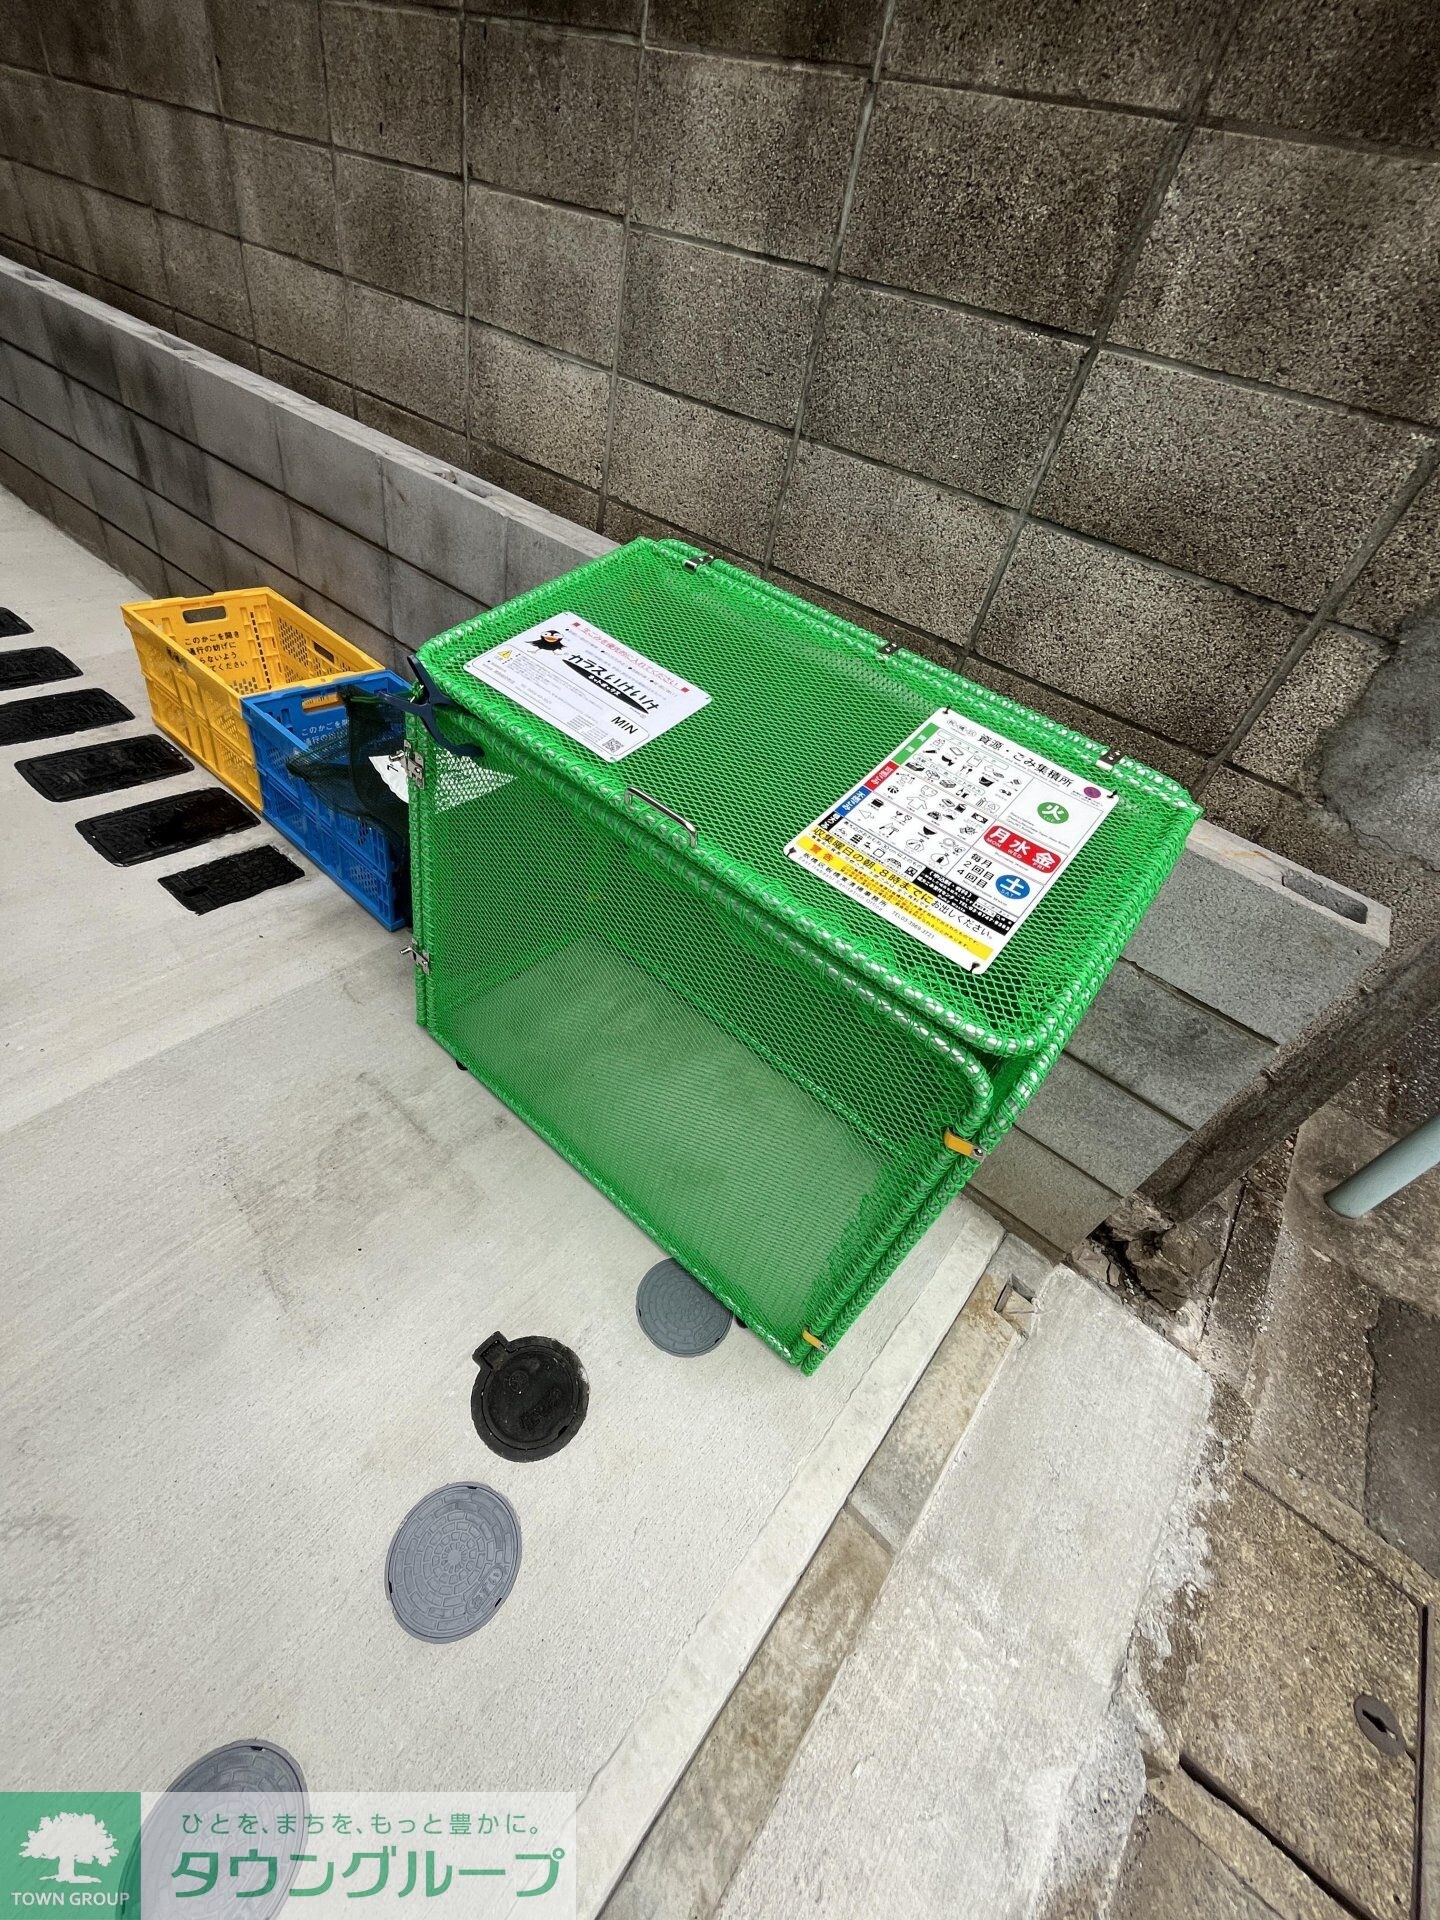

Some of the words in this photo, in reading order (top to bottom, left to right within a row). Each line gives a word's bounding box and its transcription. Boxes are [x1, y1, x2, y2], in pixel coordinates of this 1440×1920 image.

[200, 652, 237, 664] らないよう
[210, 661, 248, 672] てください
[568, 653, 660, 711] カラスいけいけ
[610, 716, 639, 734] MIN
[976, 733, 1074, 788] 資源・ごみ集積所
[1041, 805, 1066, 821] 火
[989, 826, 1009, 842] 月
[1009, 839, 1032, 854] 水
[1032, 851, 1056, 868] 金
[970, 853, 993, 868] 毎月
[811, 828, 995, 941] 収集曜日の朝、8時までにお出しください。
[957, 868, 988, 888] 4回目
[962, 859, 994, 881] 2回目
[1000, 877, 1025, 896] 土
